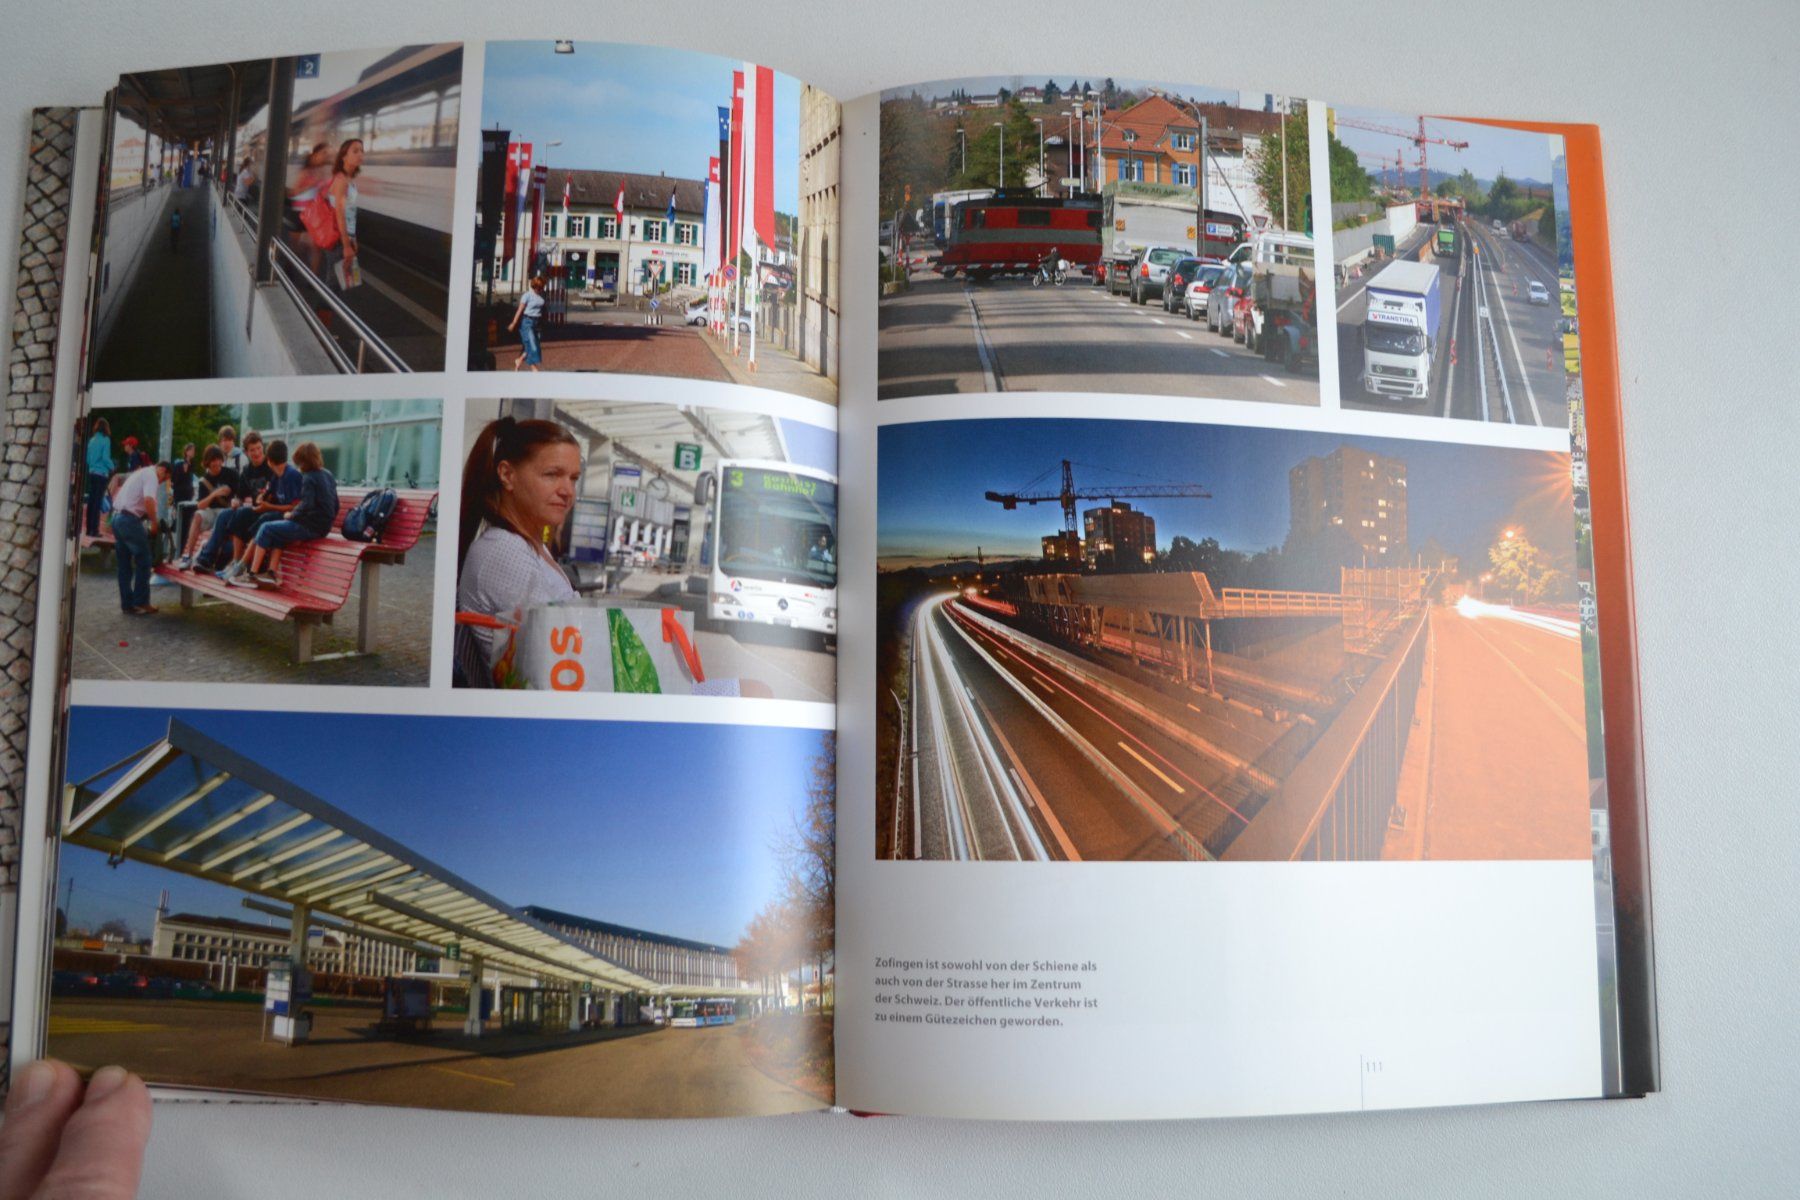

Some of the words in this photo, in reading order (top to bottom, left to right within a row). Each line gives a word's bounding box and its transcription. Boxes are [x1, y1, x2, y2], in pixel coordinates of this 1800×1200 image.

[305, 61, 314, 75] 2
[680, 450, 695, 469] B
[730, 469, 744, 488] 3
[875, 957, 923, 971] Zofingen
[926, 958, 940, 970] ist
[941, 959, 983, 971] sowohl
[986, 961, 1007, 971] von
[1010, 960, 1030, 972] der
[1033, 960, 1079, 972] Schiene
[1081, 960, 1098, 972] als
[875, 976, 900, 987] auch
[903, 979, 923, 987] von
[925, 977, 945, 989] der
[947, 978, 988, 989] Strasse
[991, 979, 1010, 990] her
[1013, 979, 1028, 990] im
[1031, 979, 1082, 990] Zentrum
[875, 993, 893, 1004] der
[895, 994, 942, 1006] Schweiz.
[945, 996, 965, 1007] Der
[968, 996, 1032, 1008] öffentliche
[1034, 998, 1081, 1009] Verkehr
[1084, 998, 1098, 1009] ist
[875, 1012, 887, 1022] zu
[890, 1013, 923, 1024] einem
[926, 1013, 997, 1026] Gütezeichen
[1000, 1016, 1064, 1029] geworden.
[1366, 1061, 1382, 1073] 111
